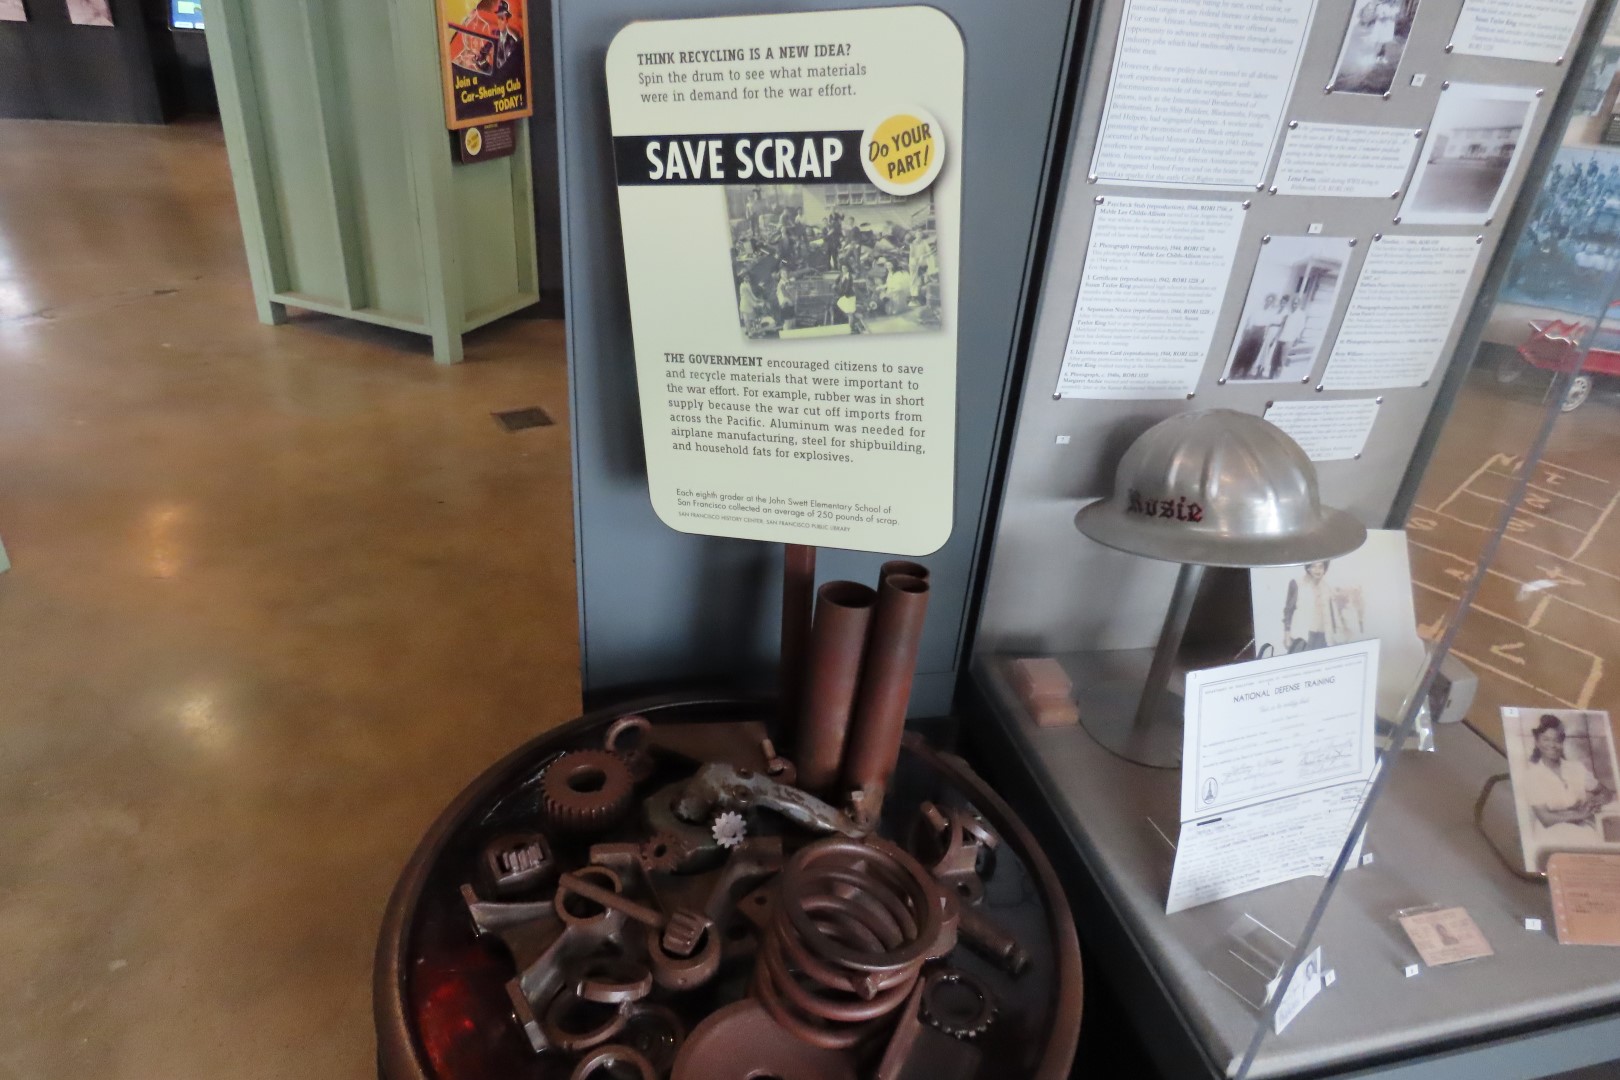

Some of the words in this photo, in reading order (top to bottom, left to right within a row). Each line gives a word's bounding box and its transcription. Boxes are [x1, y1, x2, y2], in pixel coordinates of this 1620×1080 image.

[637, 52, 674, 64] THINK
[679, 49, 744, 62] RECYCLING
[749, 48, 760, 60] IS
[765, 47, 774, 59] A
[779, 45, 808, 58] NEW
[814, 44, 850, 56] IDEA?
[455, 76, 471, 89] Join
[473, 77, 478, 85] a
[638, 72, 663, 86] Spin
[668, 71, 686, 82] the
[692, 70, 723, 81] drum
[728, 69, 740, 80] to
[745, 70, 764, 79] see
[769, 66, 801, 78] what
[806, 63, 866, 76] materials
[461, 84, 505, 104] Car-Sharing
[506, 79, 521, 92] Club
[640, 93, 667, 102] were
[672, 90, 685, 101] in
[689, 88, 737, 100] demand
[742, 87, 758, 98] for
[763, 86, 783, 98] the
[788, 87, 812, 96] war
[818, 84, 855, 96] effort.
[493, 96, 523, 112] TODAY!
[891, 123, 932, 152] YOUR
[646, 140, 725, 180] SAVE
[735, 138, 844, 179] SCRAP
[887, 145, 930, 179] PART!
[664, 353, 684, 362] THE
[688, 354, 762, 366] GOVERNMENT
[767, 360, 829, 371] encouraged
[834, 361, 877, 371] citizens
[882, 363, 892, 372] to
[897, 365, 923, 374] save
[665, 369, 685, 378] and
[689, 371, 725, 381] recycle
[730, 373, 780, 382] materials
[784, 374, 807, 384] that
[811, 377, 839, 385] were
[844, 377, 902, 388] important
[907, 380, 918, 389] to
[666, 383, 682, 392] the
[709, 385, 739, 395] effort.
[743, 387, 758, 396] For
[762, 390, 810, 401] example,
[814, 391, 850, 401] rubber
[854, 395, 876, 403] was
[880, 394, 891, 404] in
[895, 395, 924, 405] short
[668, 399, 703, 410] supply
[708, 400, 750, 411] because
[755, 402, 772, 412] the
[777, 406, 798, 414] war
[803, 406, 820, 415] cut
[825, 406, 840, 416] off
[844, 408, 889, 420] imports
[894, 410, 922, 421] from
[669, 414, 701, 422] across
[705, 414, 722, 424] the
[727, 416, 764, 426] Pacific.
[769, 418, 829, 430] Aluminum
[834, 424, 856, 432] was
[861, 425, 904, 435] needed
[909, 426, 925, 437] for
[671, 427, 712, 438] airplane
[716, 432, 797, 445] manufacturing,
[801, 436, 826, 445] steel
[830, 436, 845, 447] for
[849, 439, 925, 453] shipbuilding,
[672, 442, 691, 450] and
[695, 443, 748, 454] household
[752, 446, 771, 456] fats
[775, 447, 789, 457] for
[793, 451, 853, 461] explosives.
[676, 488, 693, 498] Each
[695, 491, 717, 499] eighth
[719, 493, 743, 503] grader
[755, 495, 766, 503] the
[768, 496, 785, 504] John
[787, 498, 807, 506] Swett
[810, 500, 852, 511] Elementary
[854, 503, 880, 512] School
[882, 505, 891, 513] of
[692, 500, 726, 509] Francisco
[728, 503, 760, 512] collected
[774, 509, 804, 517] average
[806, 509, 814, 517] of
[816, 510, 833, 518] 250
[835, 513, 864, 521] pounds
[865, 514, 873, 522] of
[1233, 690, 1271, 703] NATIONAL
[1274, 683, 1300, 695] DEFENSE
[1303, 675, 1336, 690] TRAINING
